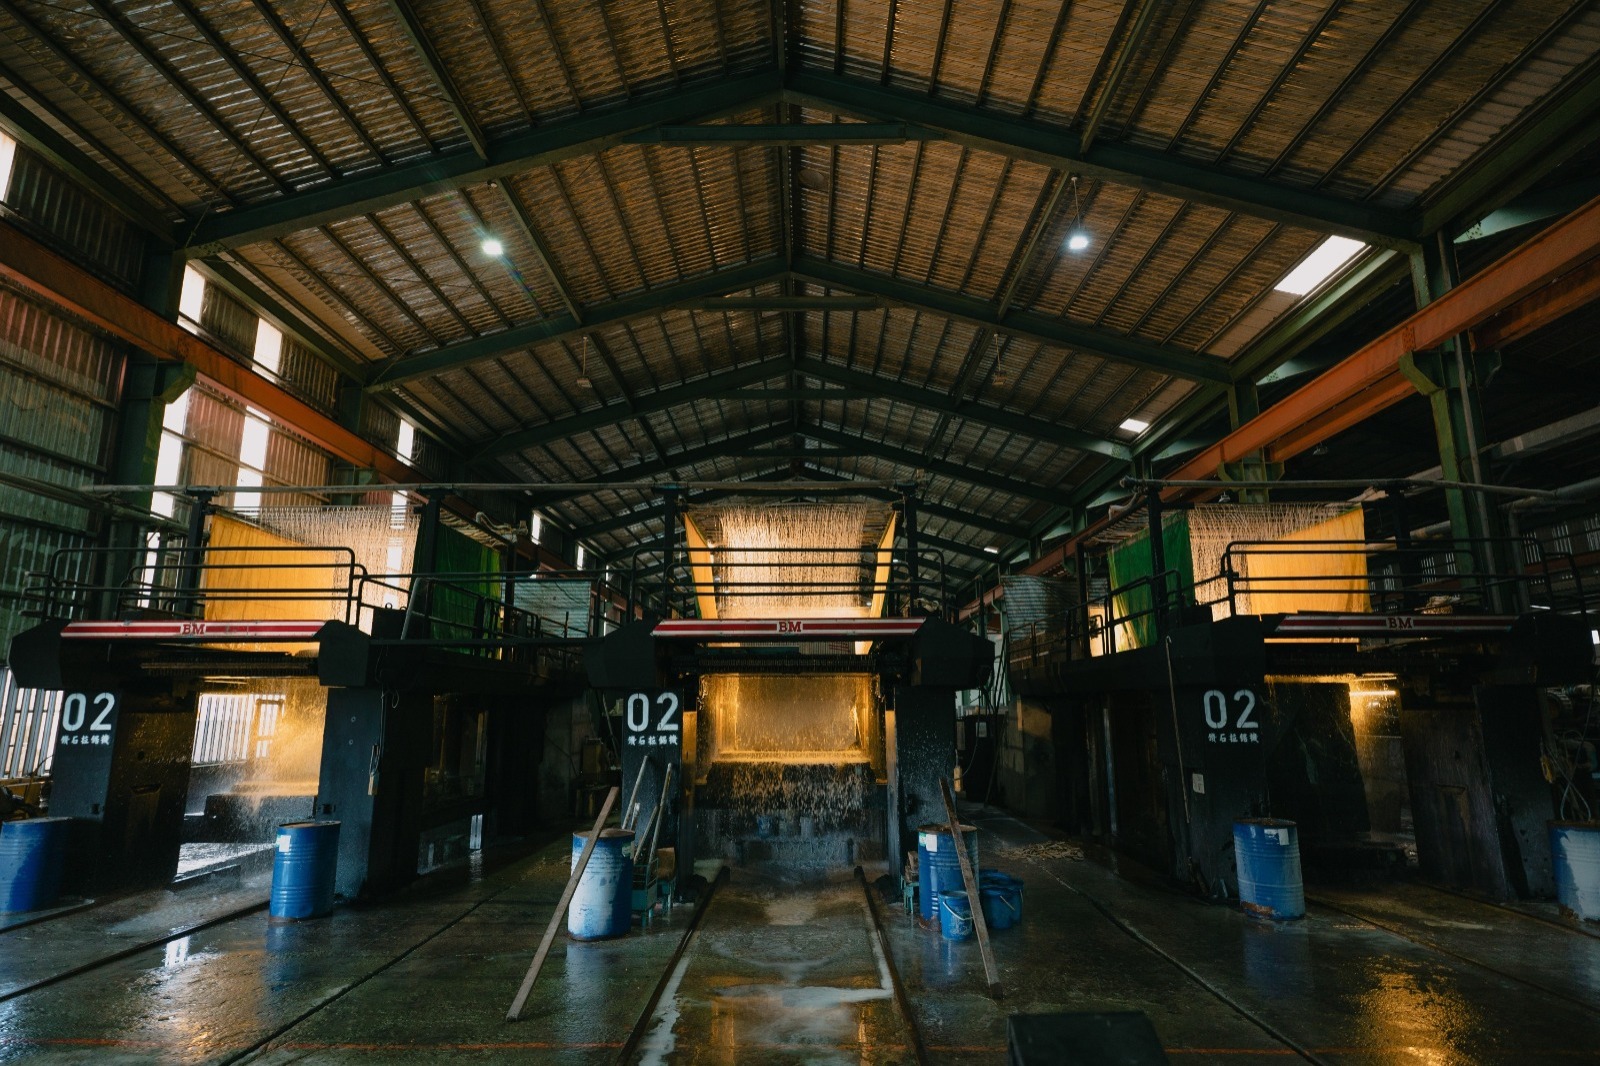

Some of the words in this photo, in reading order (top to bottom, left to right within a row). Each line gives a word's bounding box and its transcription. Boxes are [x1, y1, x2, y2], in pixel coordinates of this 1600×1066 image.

[182, 623, 205, 635] BM
[779, 621, 802, 633] BM
[1388, 617, 1412, 629] BM
[62, 692, 115, 731] 02
[627, 692, 678, 732] 02
[1203, 689, 1259, 729] 02
